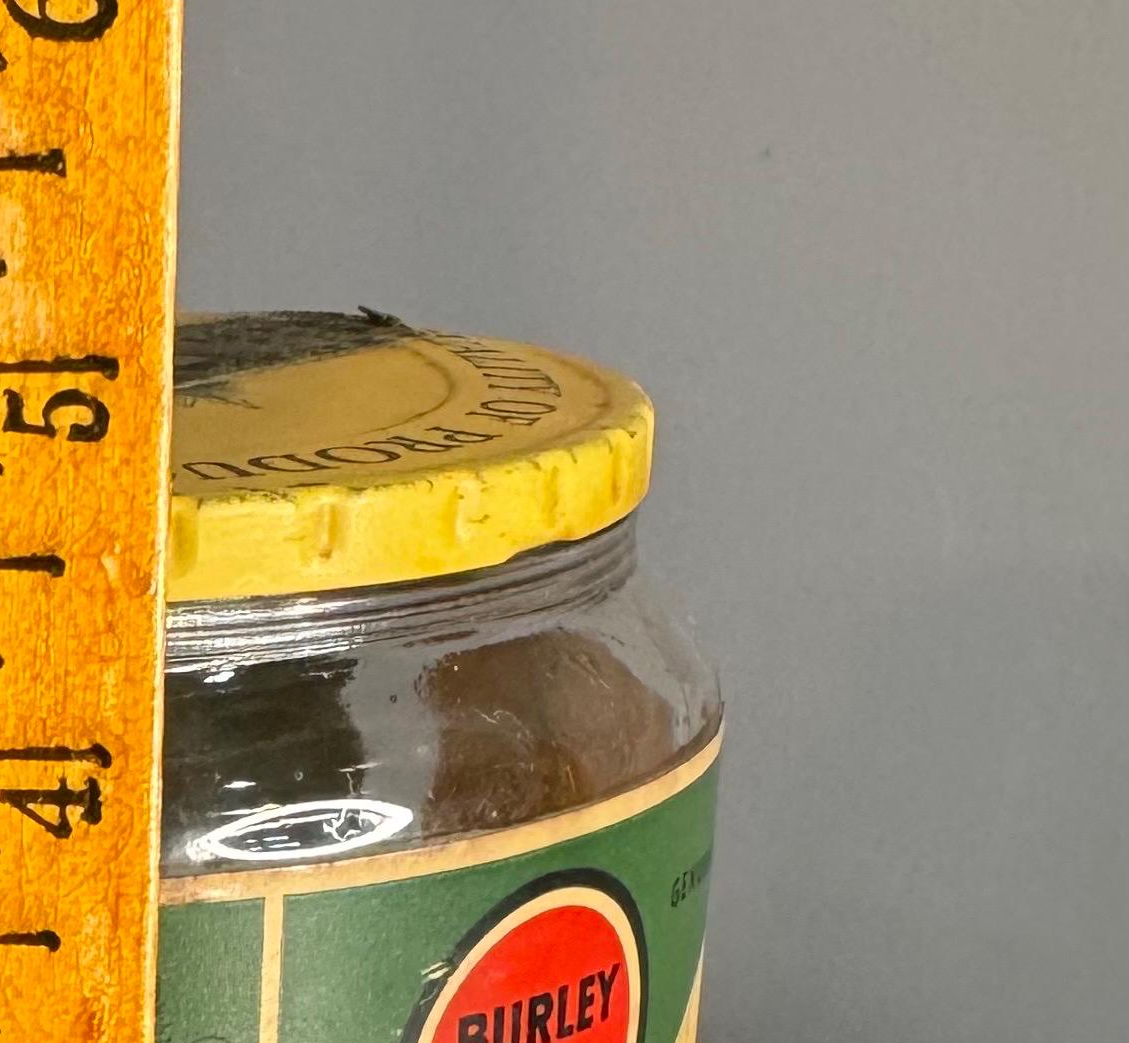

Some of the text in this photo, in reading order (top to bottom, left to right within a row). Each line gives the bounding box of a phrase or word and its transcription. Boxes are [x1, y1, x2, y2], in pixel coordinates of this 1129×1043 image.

[2, 388, 111, 442] 5
[171, 425, 504, 481] PRODU
[0, 776, 104, 839] 4
